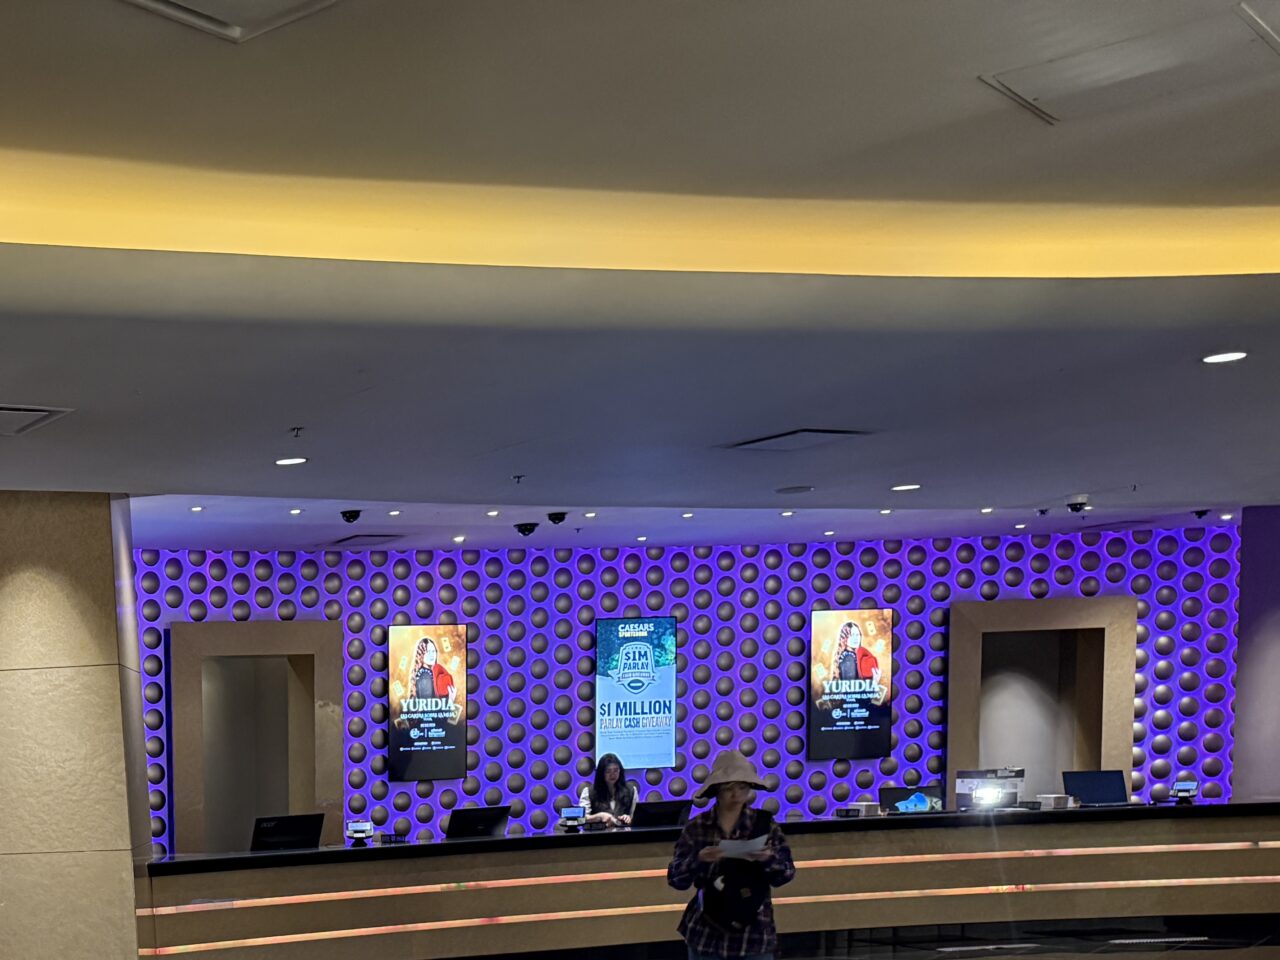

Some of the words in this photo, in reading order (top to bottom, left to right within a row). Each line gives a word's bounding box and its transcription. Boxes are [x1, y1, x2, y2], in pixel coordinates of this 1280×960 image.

[618, 623, 654, 631] CAESARS
[623, 662, 649, 671] PARLAY
[822, 680, 879, 693] YURIDIA
[400, 698, 456, 712] YURIDIA
[600, 703, 611, 716] $1
[616, 700, 672, 716] MILLION
[600, 718, 623, 730] PARLAY
[624, 717, 640, 728] CASH
[642, 716, 672, 728] GIVEAWAY
